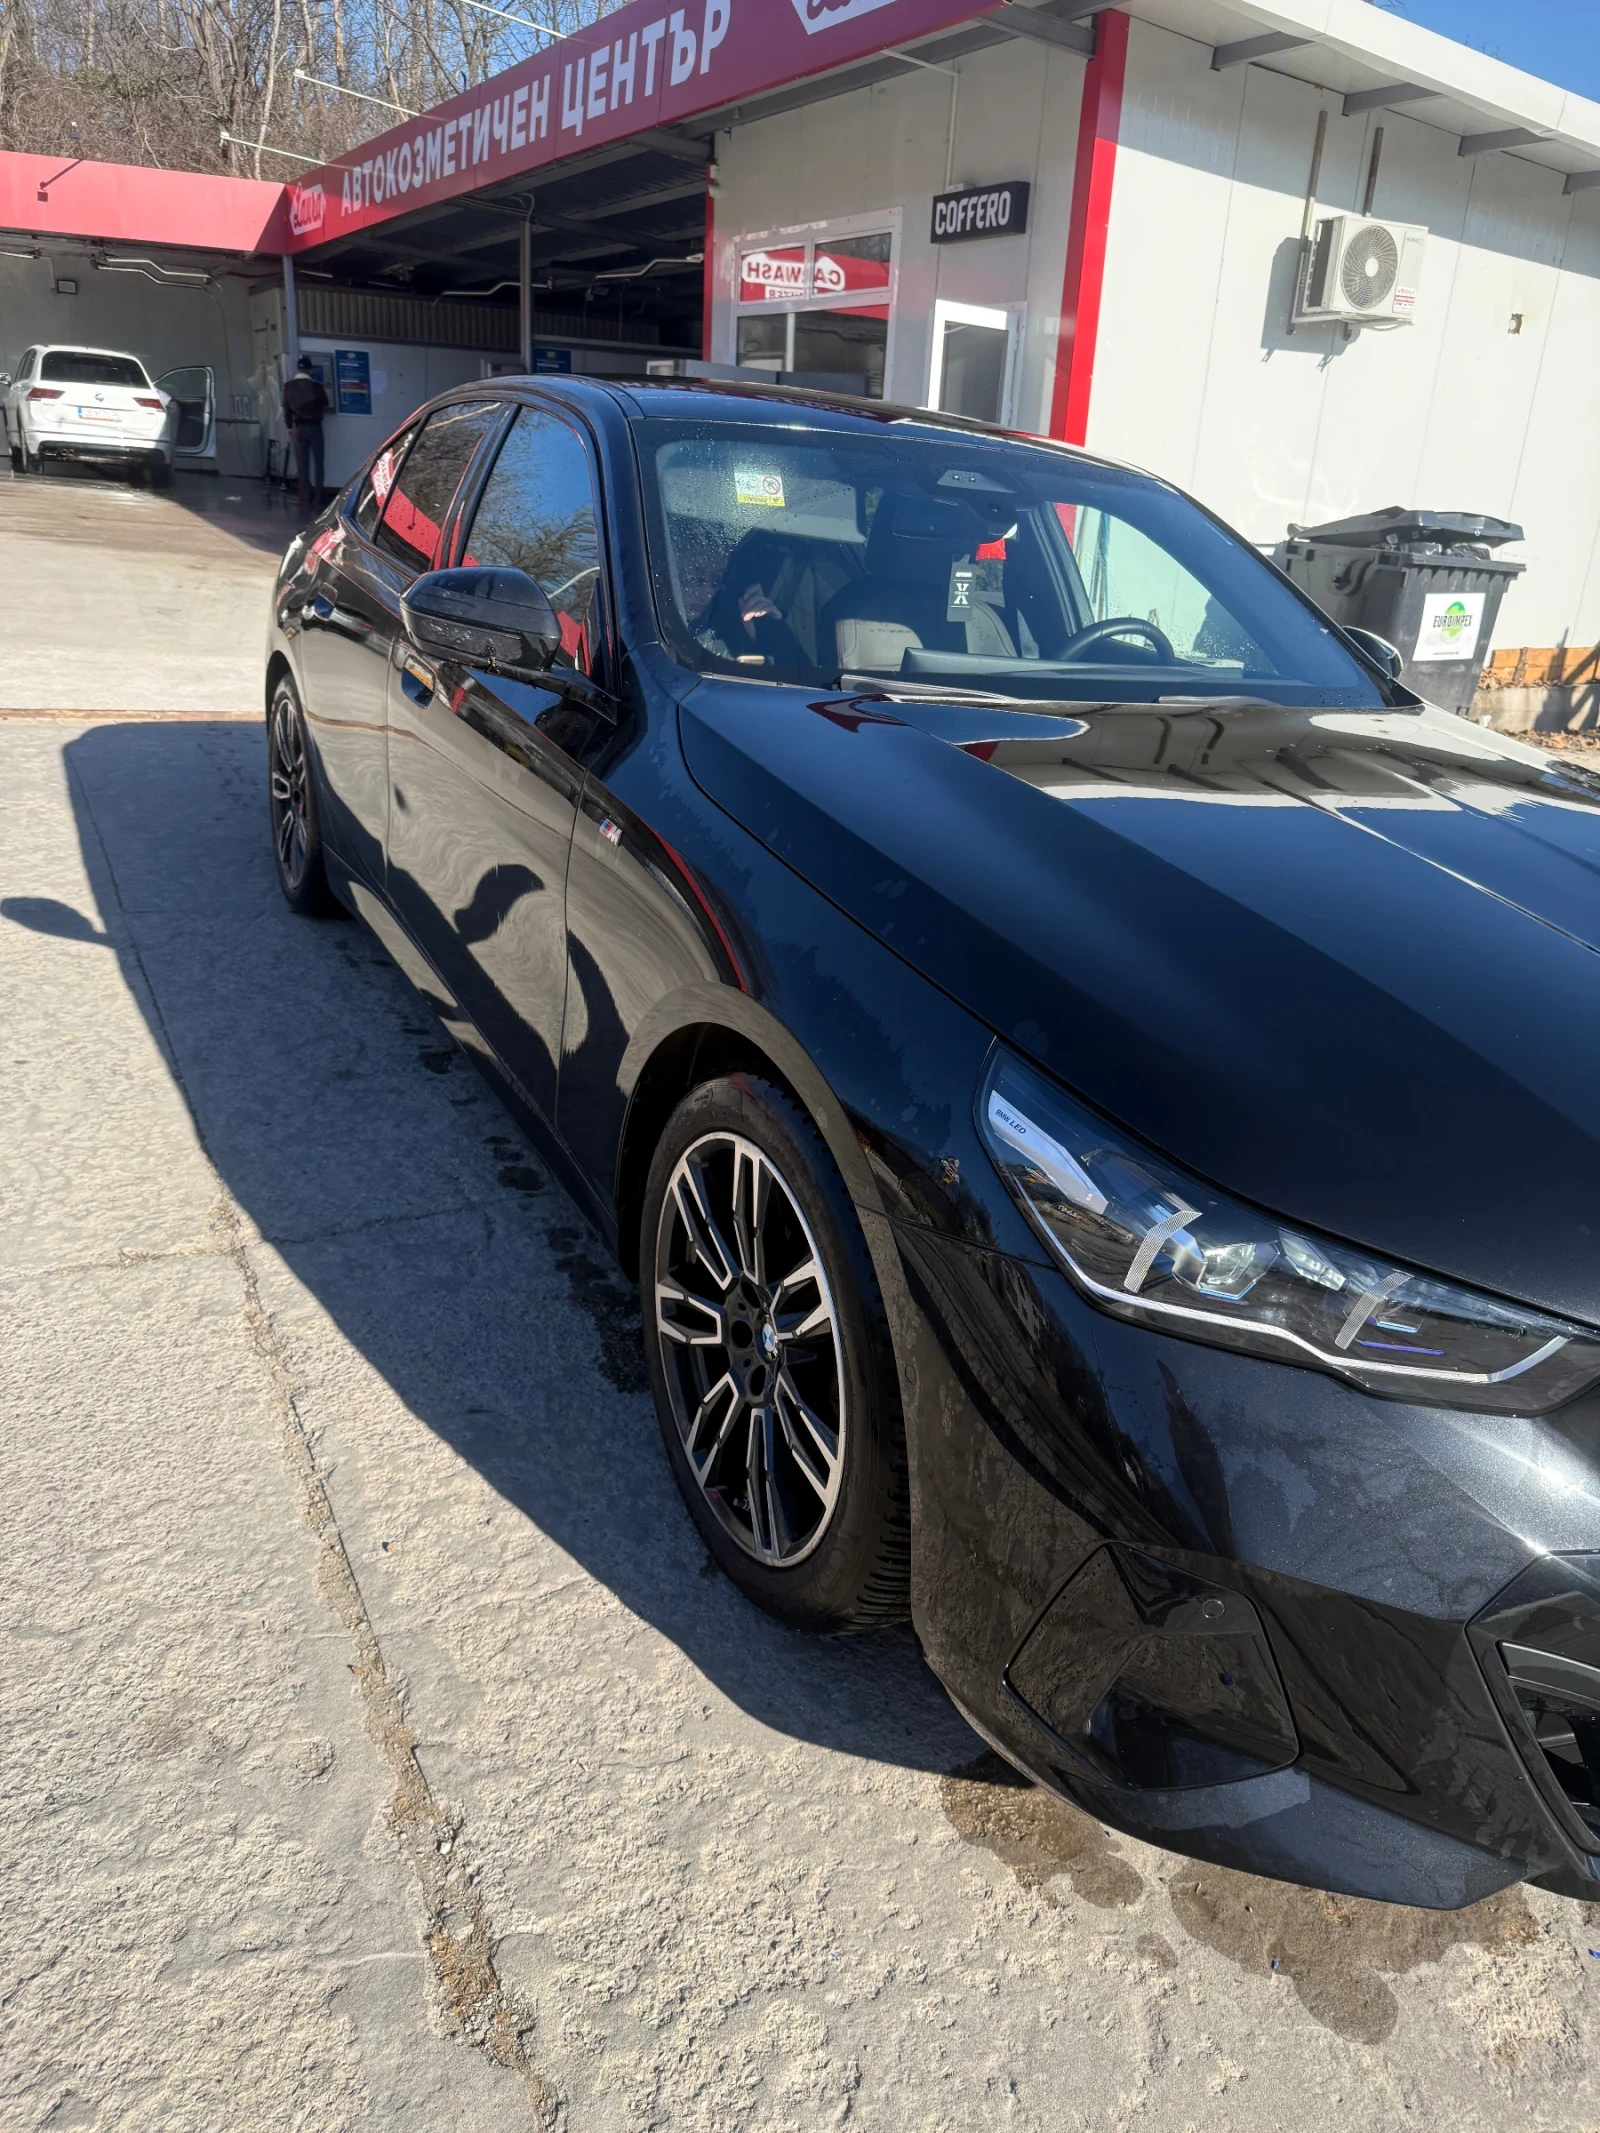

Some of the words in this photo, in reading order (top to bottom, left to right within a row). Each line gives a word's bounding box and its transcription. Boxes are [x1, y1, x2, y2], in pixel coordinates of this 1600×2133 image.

[340, 75, 551, 217] АВТОКОЗМЕТИЧЕН
[561, 0, 731, 137] ЦЕНТЪР
[935, 191, 1011, 235] COFFERO
[1433, 614, 1473, 628] EUROIMPEX
[995, 1109, 1011, 1123] BMW
[1009, 1120, 1027, 1134] LED
